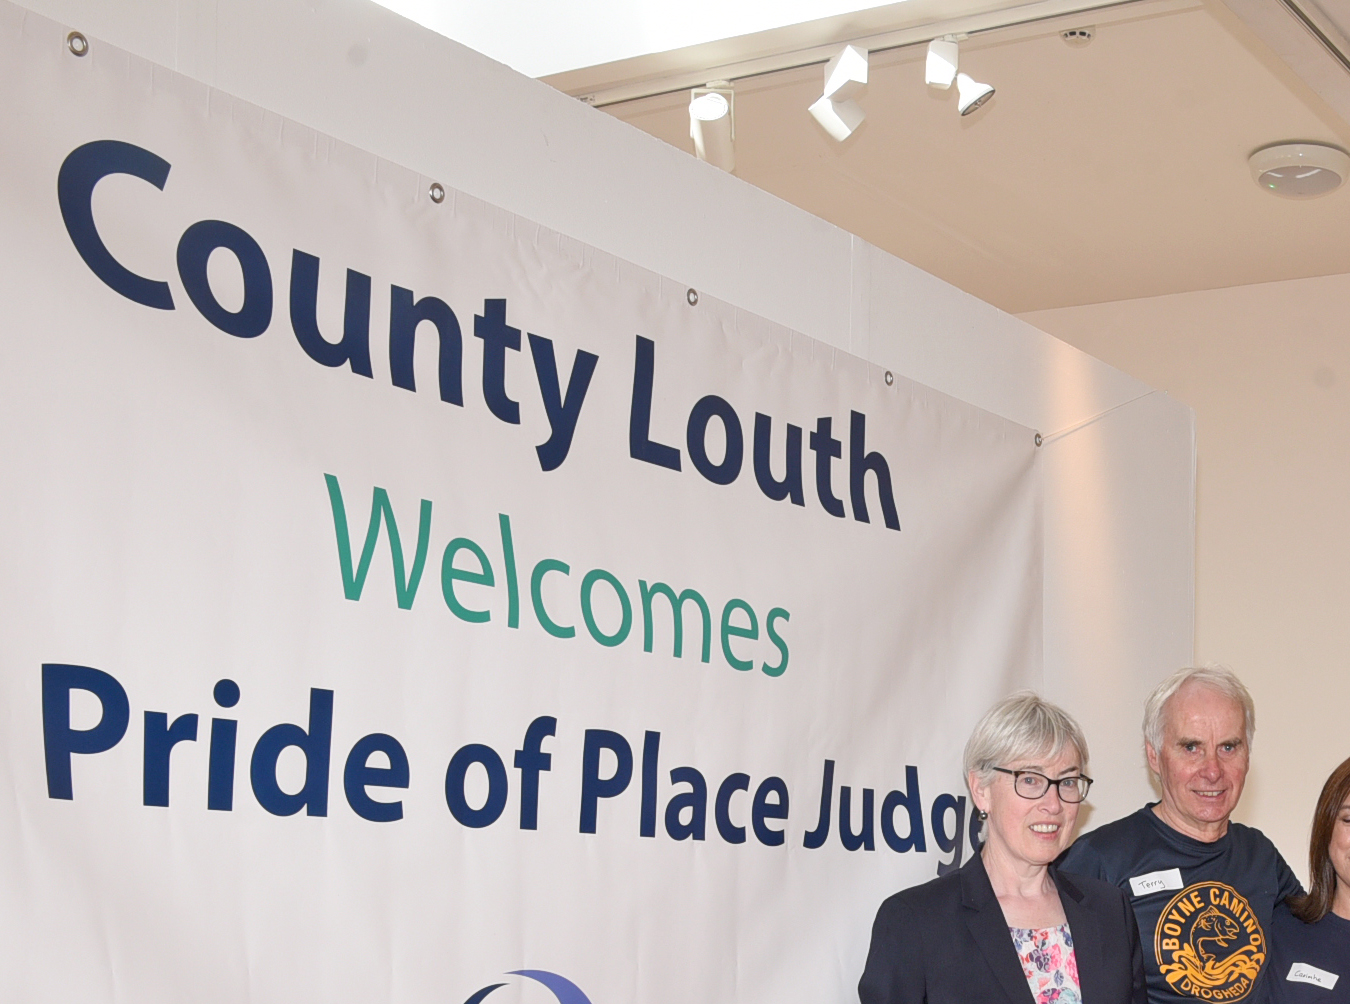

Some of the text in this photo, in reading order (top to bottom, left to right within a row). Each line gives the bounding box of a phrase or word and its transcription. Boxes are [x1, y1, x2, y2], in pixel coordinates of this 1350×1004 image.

[58, 139, 901, 531] County Louth
[324, 473, 790, 677] Welcomes
[41, 663, 409, 822] Pride
[445, 716, 557, 831] of
[579, 728, 790, 846] Place
[1138, 880, 1165, 889] Terry
[1162, 888, 1262, 950] BOYNE CAMINO
[1180, 977, 1250, 1000] DROGHEDA
